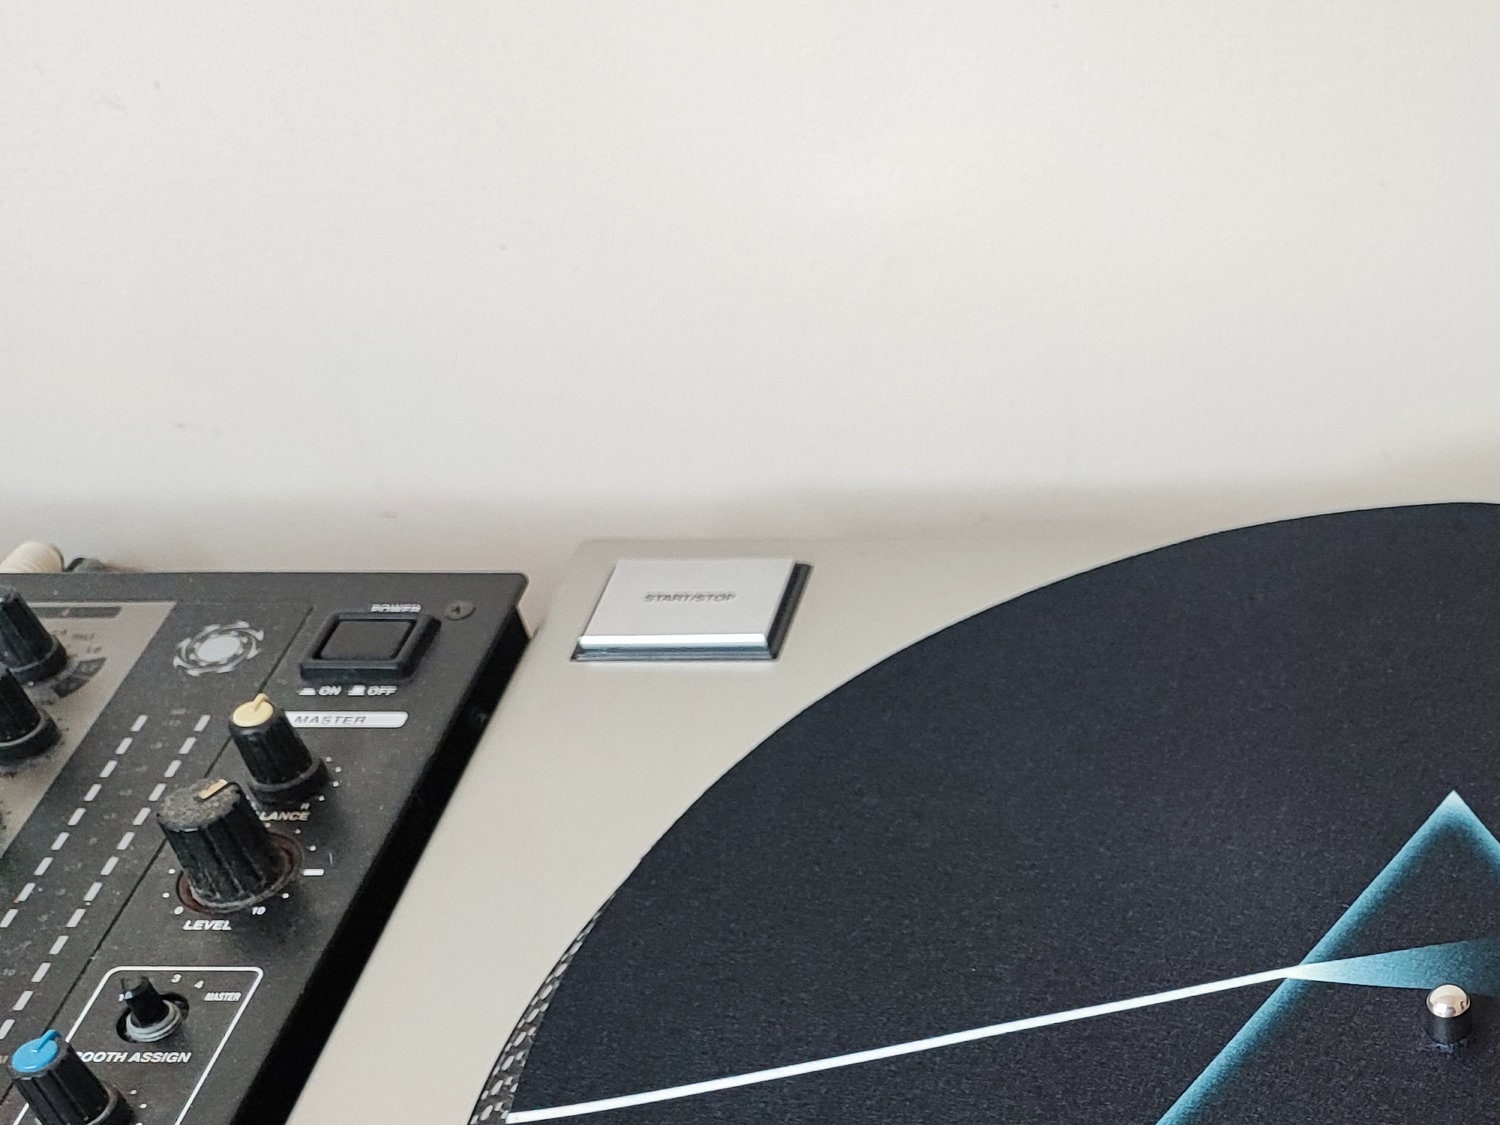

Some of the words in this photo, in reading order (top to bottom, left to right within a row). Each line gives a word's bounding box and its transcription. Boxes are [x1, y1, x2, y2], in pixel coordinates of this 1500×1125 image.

[644, 592, 737, 603] START/STOP
[370, 604, 421, 613] POWER
[318, 686, 342, 696] ON
[367, 686, 398, 696] OFF
[294, 715, 367, 725] MASTER
[259, 811, 311, 821] LANCE
[252, 906, 266, 915] 10
[183, 920, 232, 931] LEVEL
[171, 974, 182, 983] 3
[194, 980, 204, 989] 4
[204, 992, 242, 1002] MASTER
[128, 1051, 192, 1063] ASSIGN
